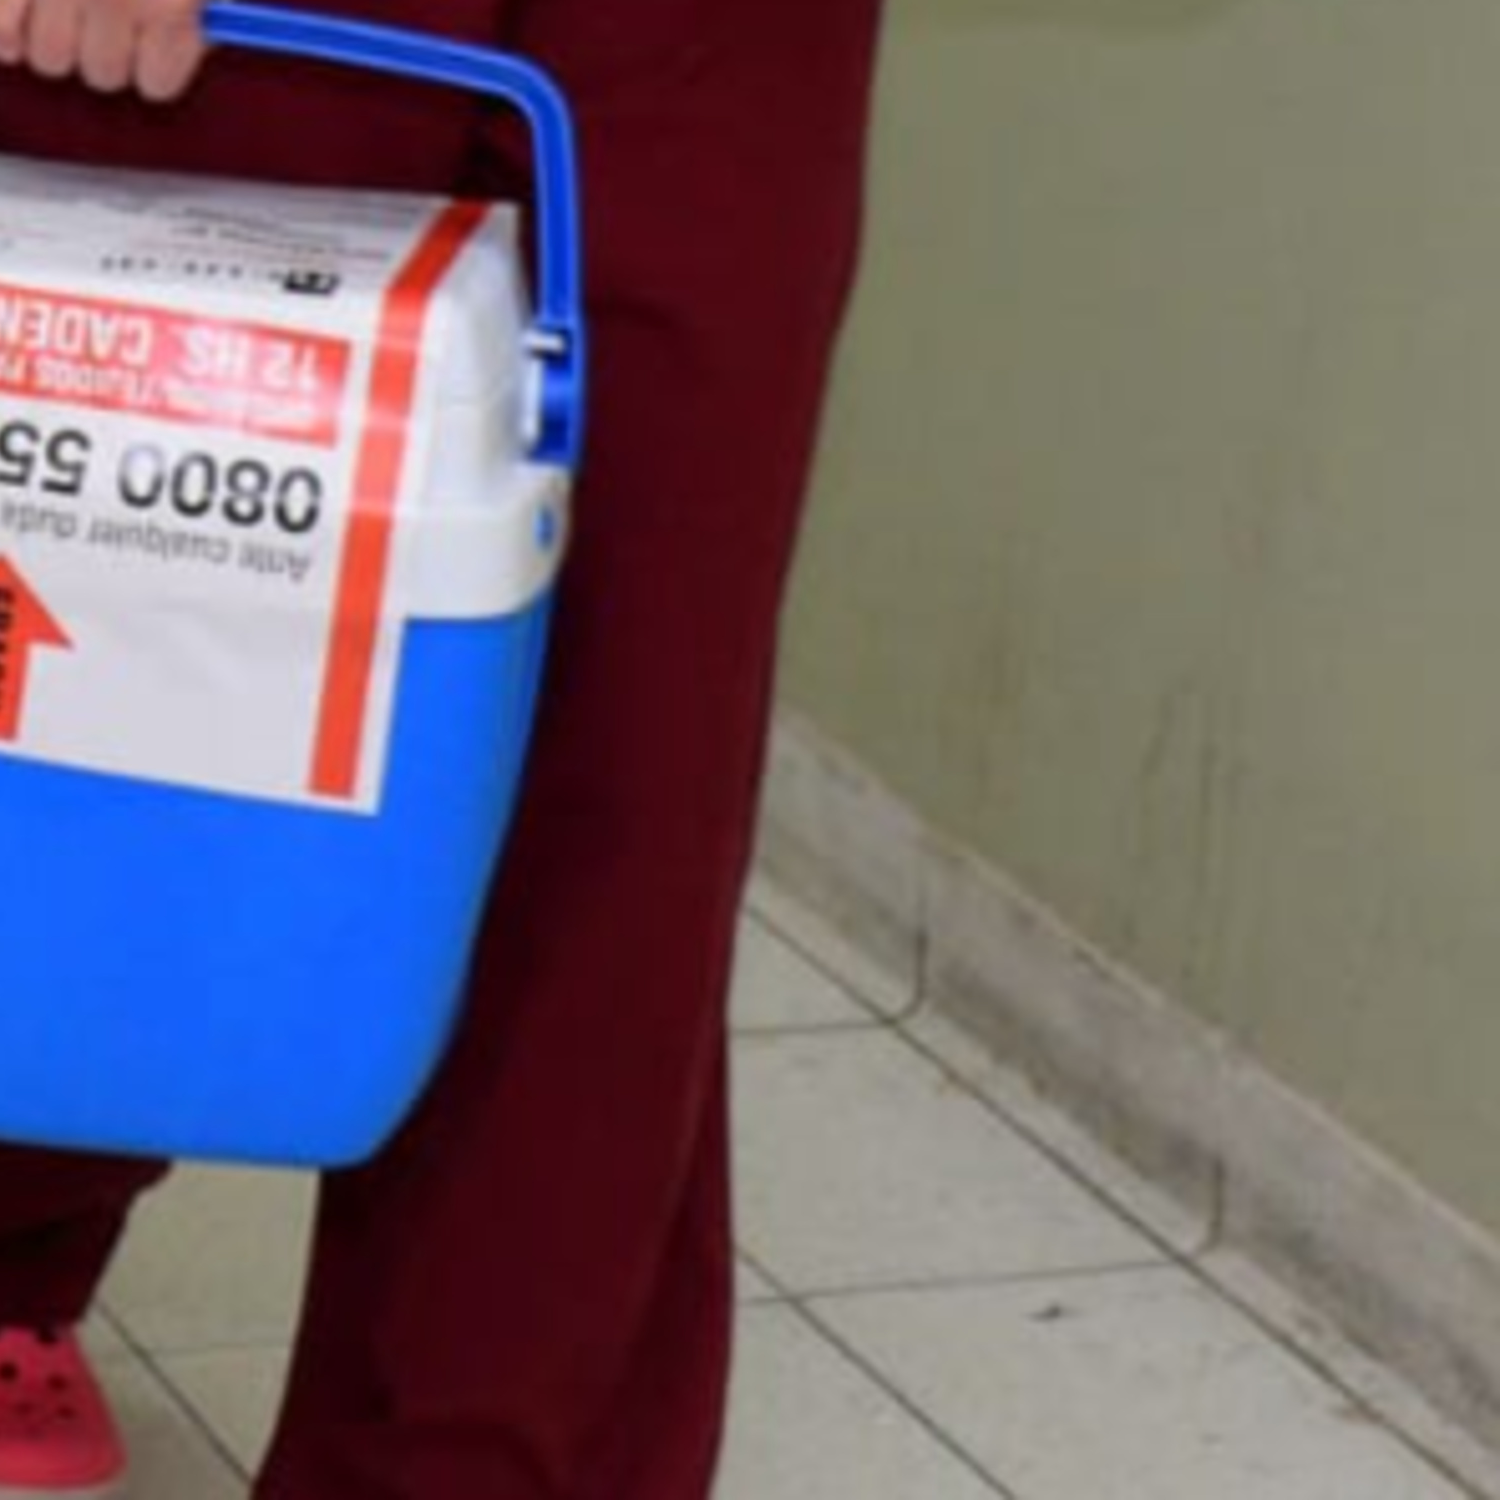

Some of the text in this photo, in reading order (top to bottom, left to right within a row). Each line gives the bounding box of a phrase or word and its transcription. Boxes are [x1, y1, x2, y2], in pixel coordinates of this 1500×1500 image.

[118, 442, 323, 534] 0800
[0, 498, 77, 539] duda
[88, 514, 231, 564] cualquier
[238, 540, 312, 584] Ante
